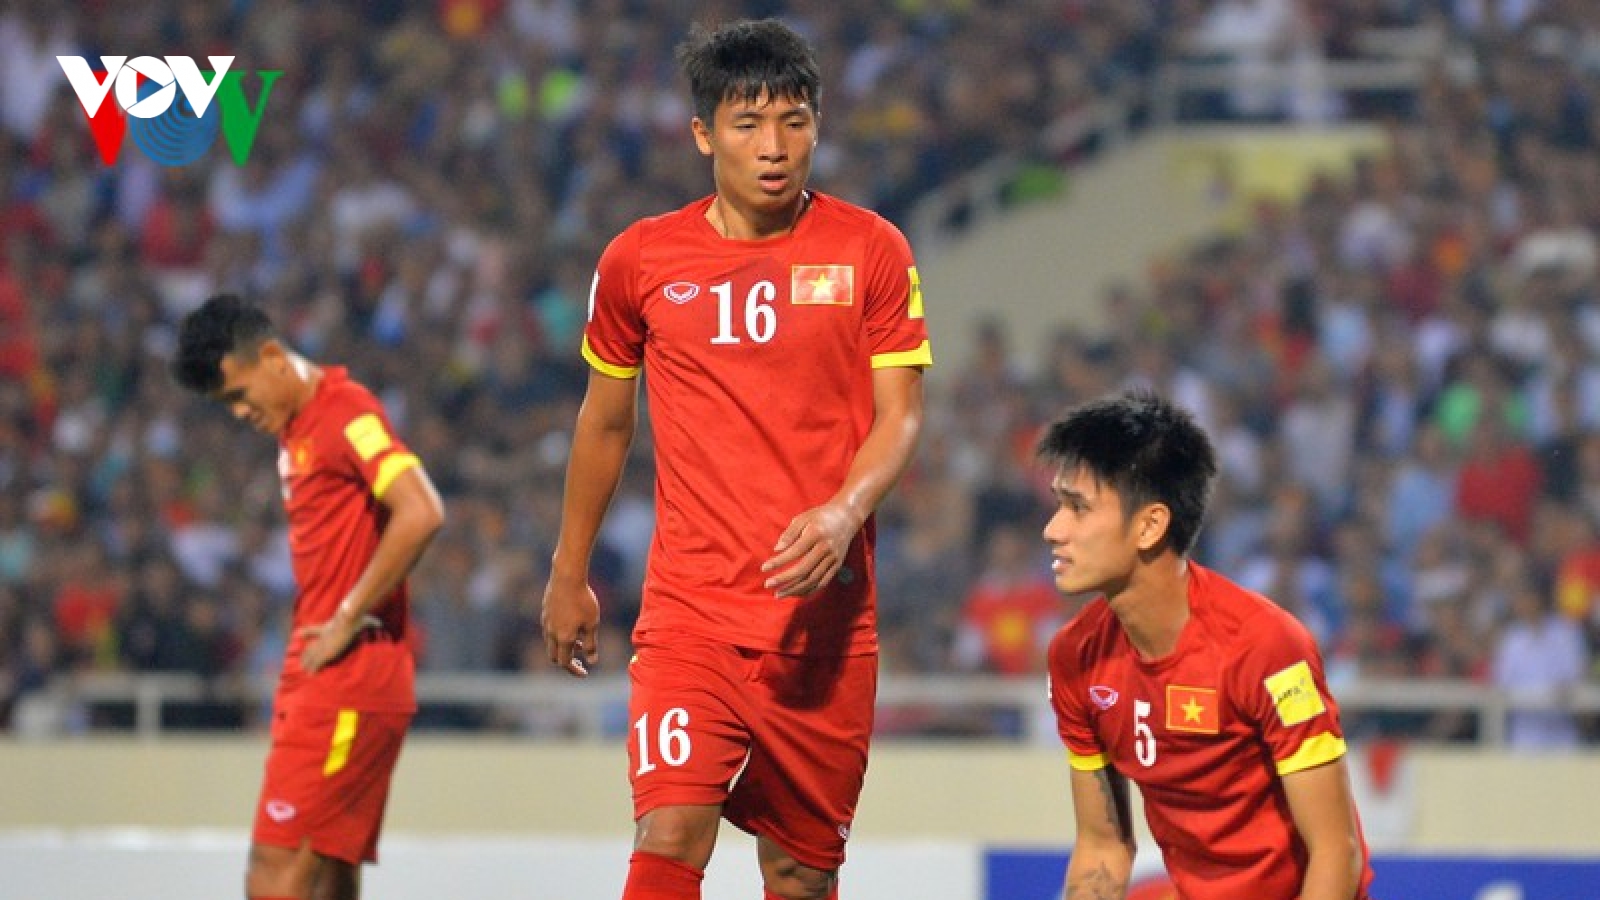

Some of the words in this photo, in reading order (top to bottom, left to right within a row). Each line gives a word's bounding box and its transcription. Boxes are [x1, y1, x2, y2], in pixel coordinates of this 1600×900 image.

[709, 280, 777, 345] 16
[633, 707, 692, 777] 16
[1133, 699, 1157, 767] 5
